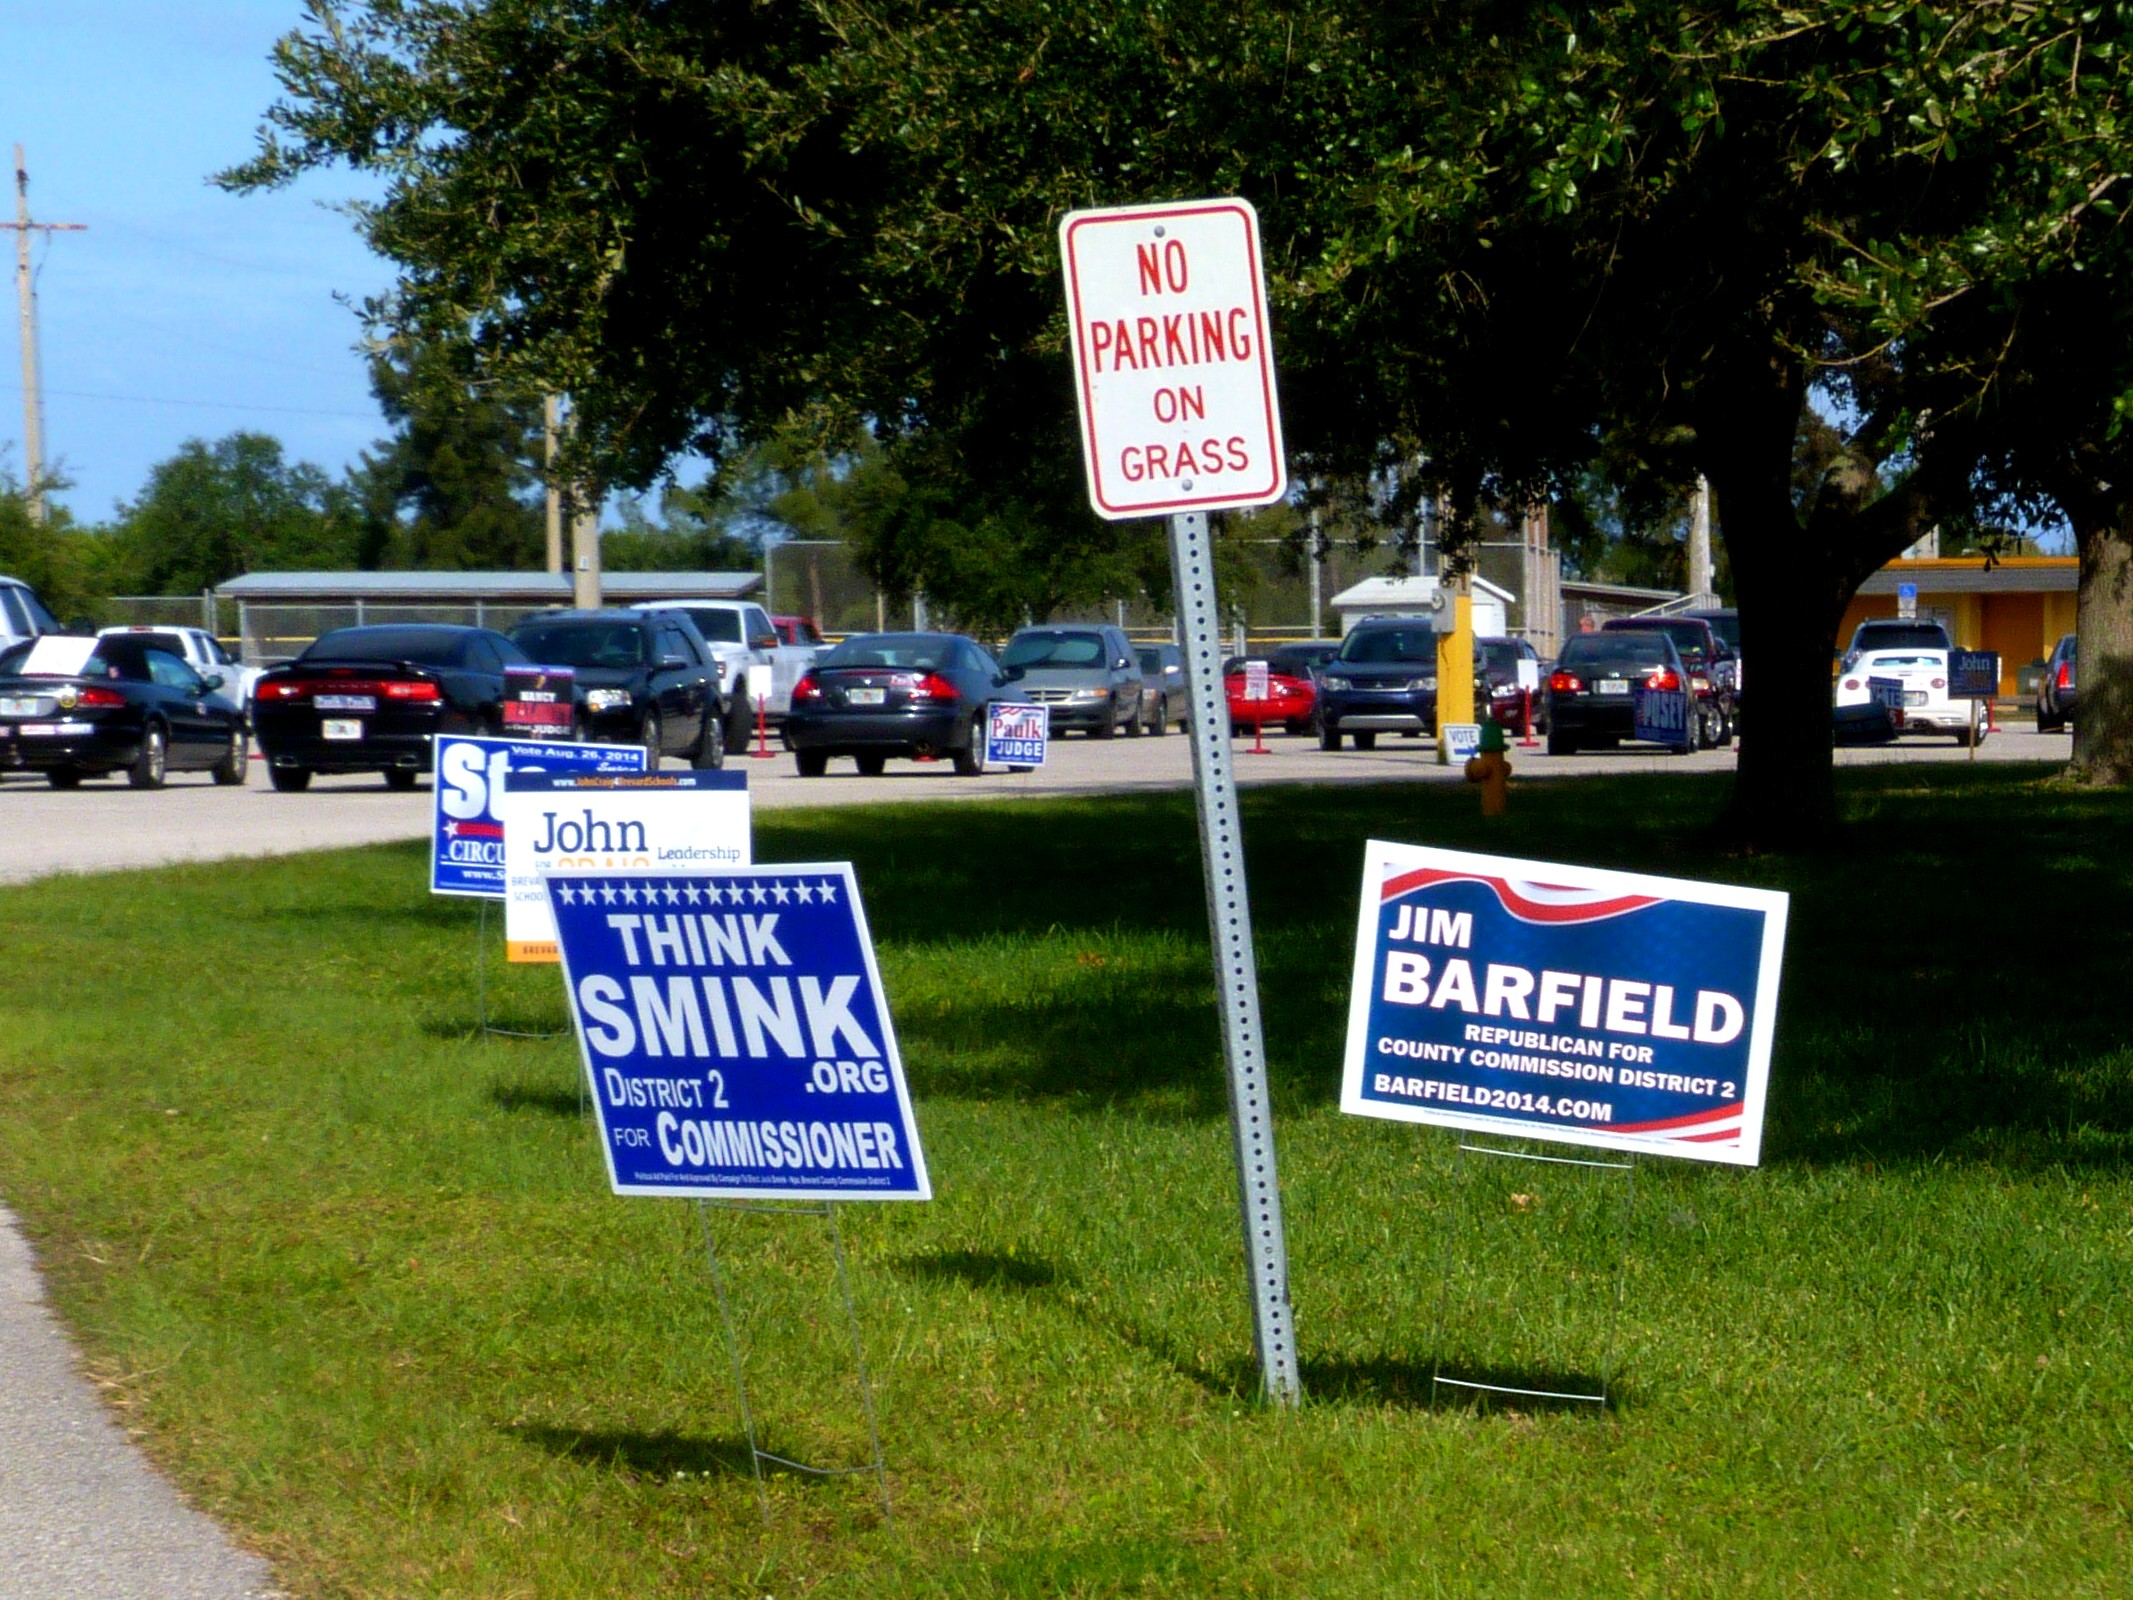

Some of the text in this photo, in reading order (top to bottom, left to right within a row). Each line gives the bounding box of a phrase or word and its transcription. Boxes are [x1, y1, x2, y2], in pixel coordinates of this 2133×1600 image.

[1136, 239, 1189, 296] NO
[1090, 307, 1252, 374] PARKING
[1152, 385, 1206, 424] ON
[1119, 436, 1250, 482] GRASS
[531, 725, 572, 735] JUDGE
[991, 718, 1042, 739] Paulk
[996, 741, 1042, 757] JUDGE
[1448, 730, 1476, 743] VOTE
[512, 745, 543, 757] Vote
[545, 748, 576, 760] Aug.
[606, 751, 639, 762] 2014
[533, 808, 649, 854] John
[657, 846, 741, 863] Leadership
[606, 913, 793, 967] THINK
[1387, 903, 1473, 949] JIM
[578, 974, 882, 1059] SMINK
[1381, 949, 1745, 1046] BARFIELD
[1464, 1023, 1654, 1065] REPUBLICAN FOR
[708, 1068, 730, 1109] 2
[804, 1060, 890, 1094] .ORG
[1377, 1036, 1736, 1099] COUNTY COMMISSION DISTRICT 2
[1373, 1073, 1613, 1122] BARFIELD2014.COM
[614, 1127, 651, 1148] FOR
